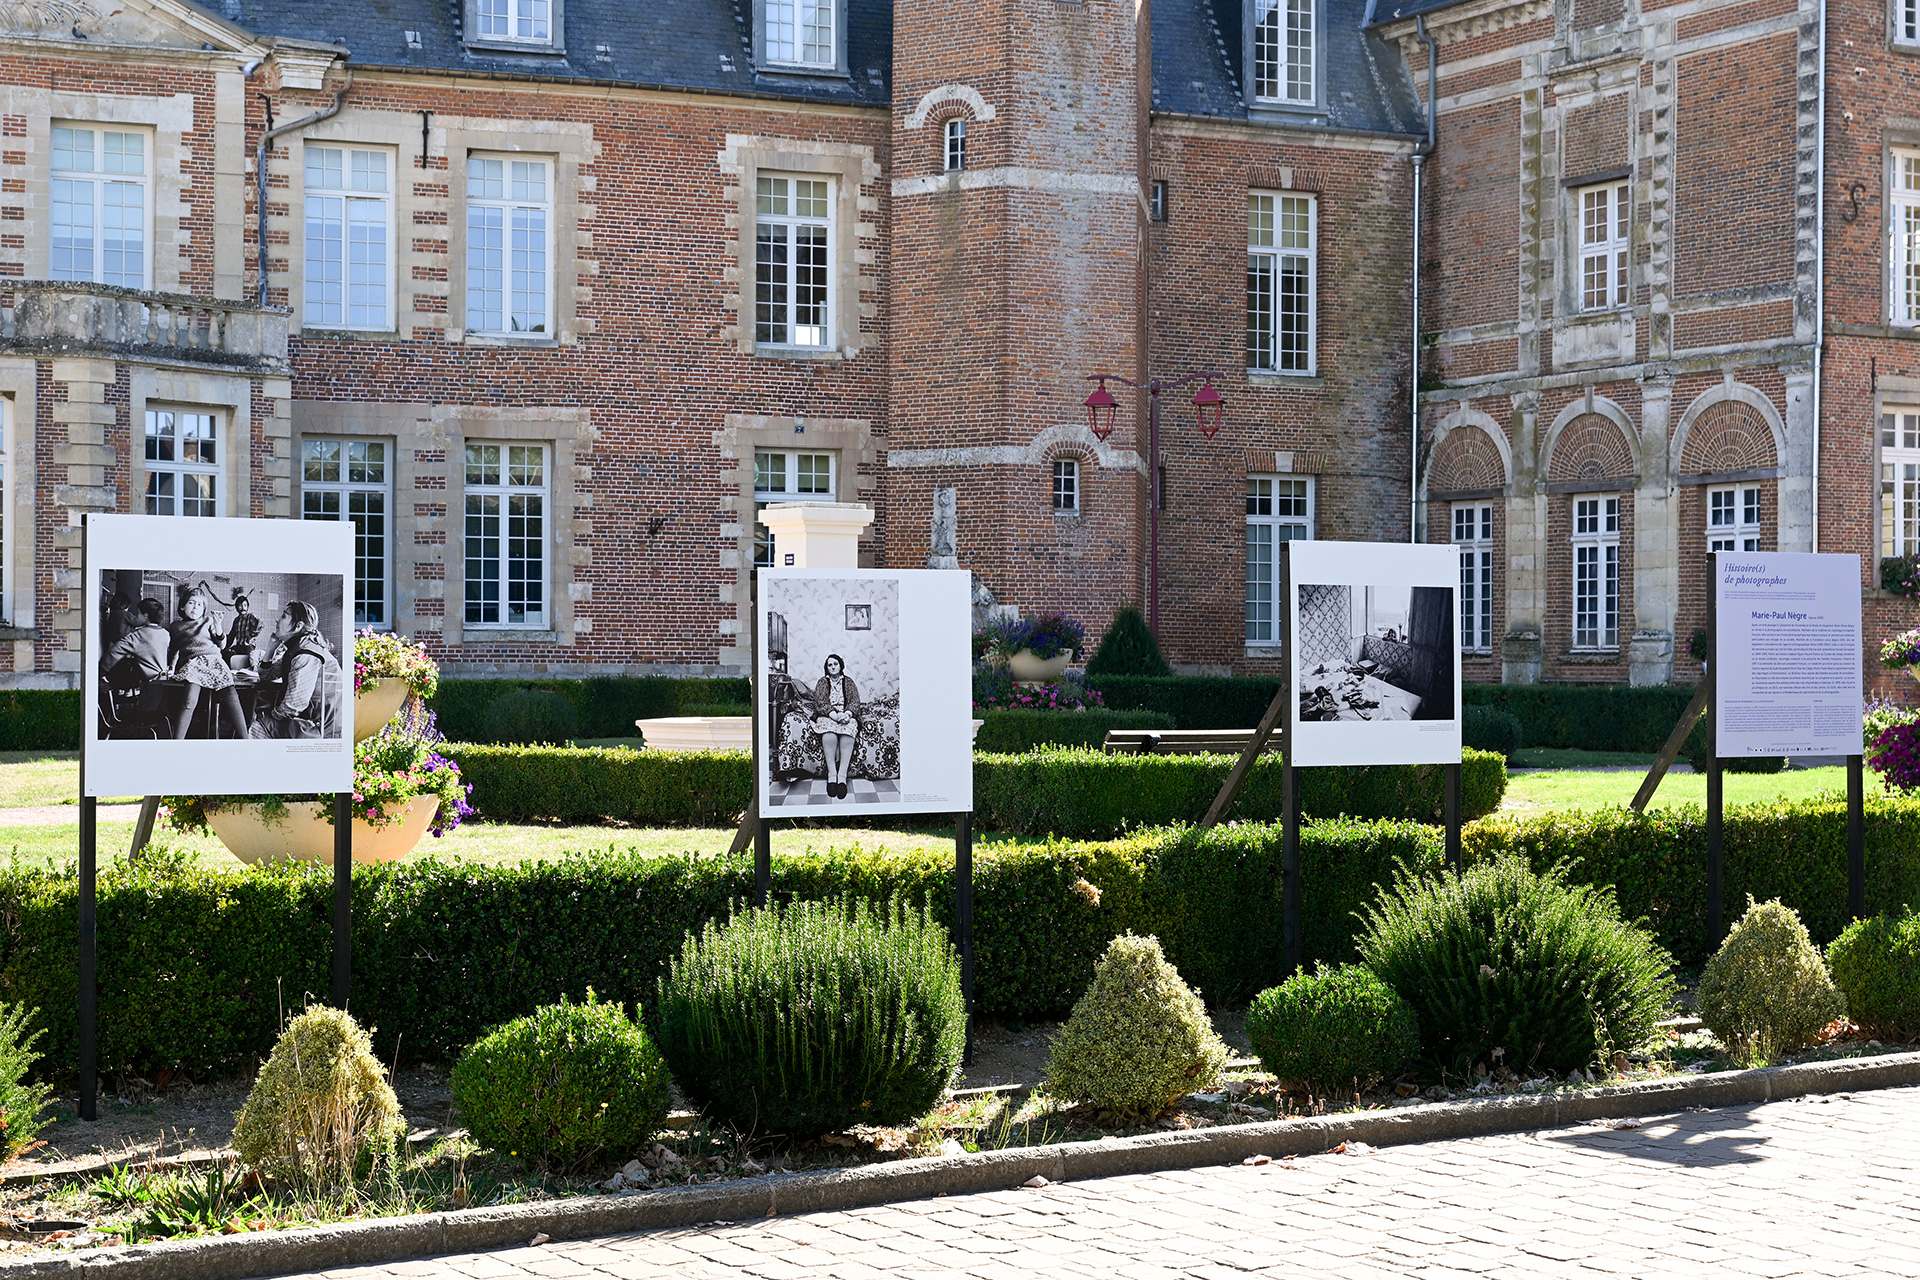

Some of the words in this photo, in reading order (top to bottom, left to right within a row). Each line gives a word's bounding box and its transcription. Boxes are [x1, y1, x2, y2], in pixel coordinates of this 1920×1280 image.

[1724, 563, 1766, 573] Histoire(s)
[1724, 575, 1734, 584] de
[1735, 575, 1787, 587] photographes
[1751, 611, 1787, 620] Marie-Paul
[1788, 611, 1807, 621] Nègre
